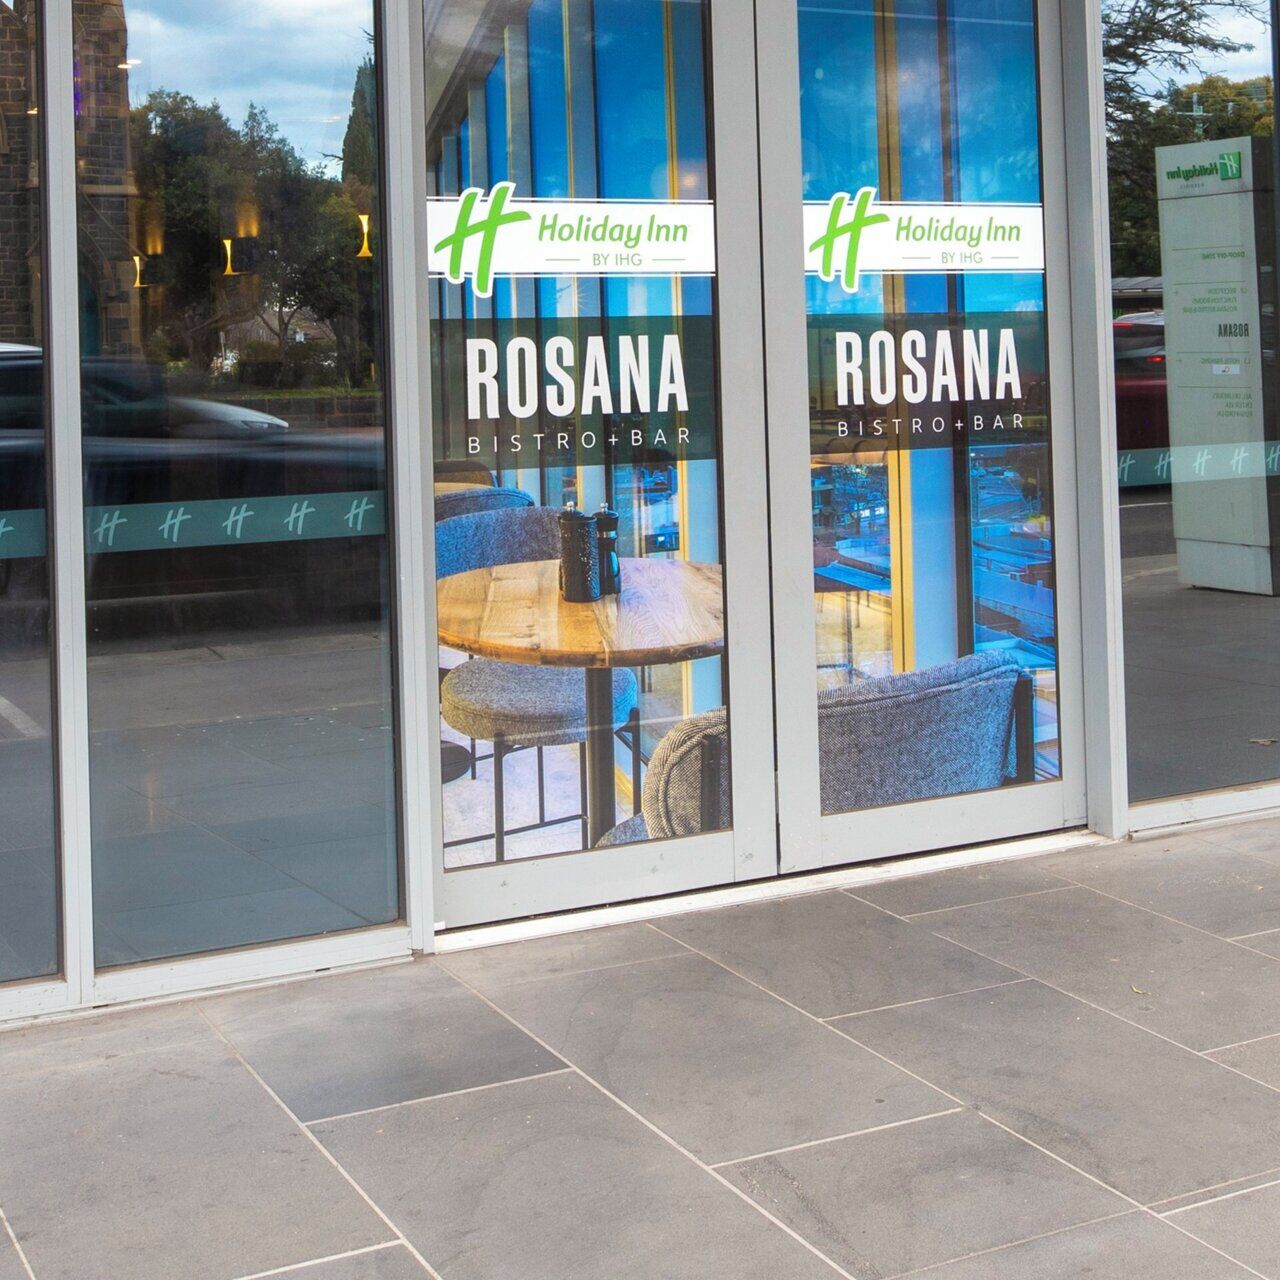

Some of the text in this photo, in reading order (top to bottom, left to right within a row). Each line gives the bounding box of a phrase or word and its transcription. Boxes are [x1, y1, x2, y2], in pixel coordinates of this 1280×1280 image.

[538, 213, 689, 249] Holiday Inn
[895, 215, 1021, 248] Holiday Inn
[592, 253, 644, 266] BY IHG
[941, 252, 984, 264] BY IHG
[466, 334, 689, 420] ROSANA
[835, 328, 1022, 406] ROSANA
